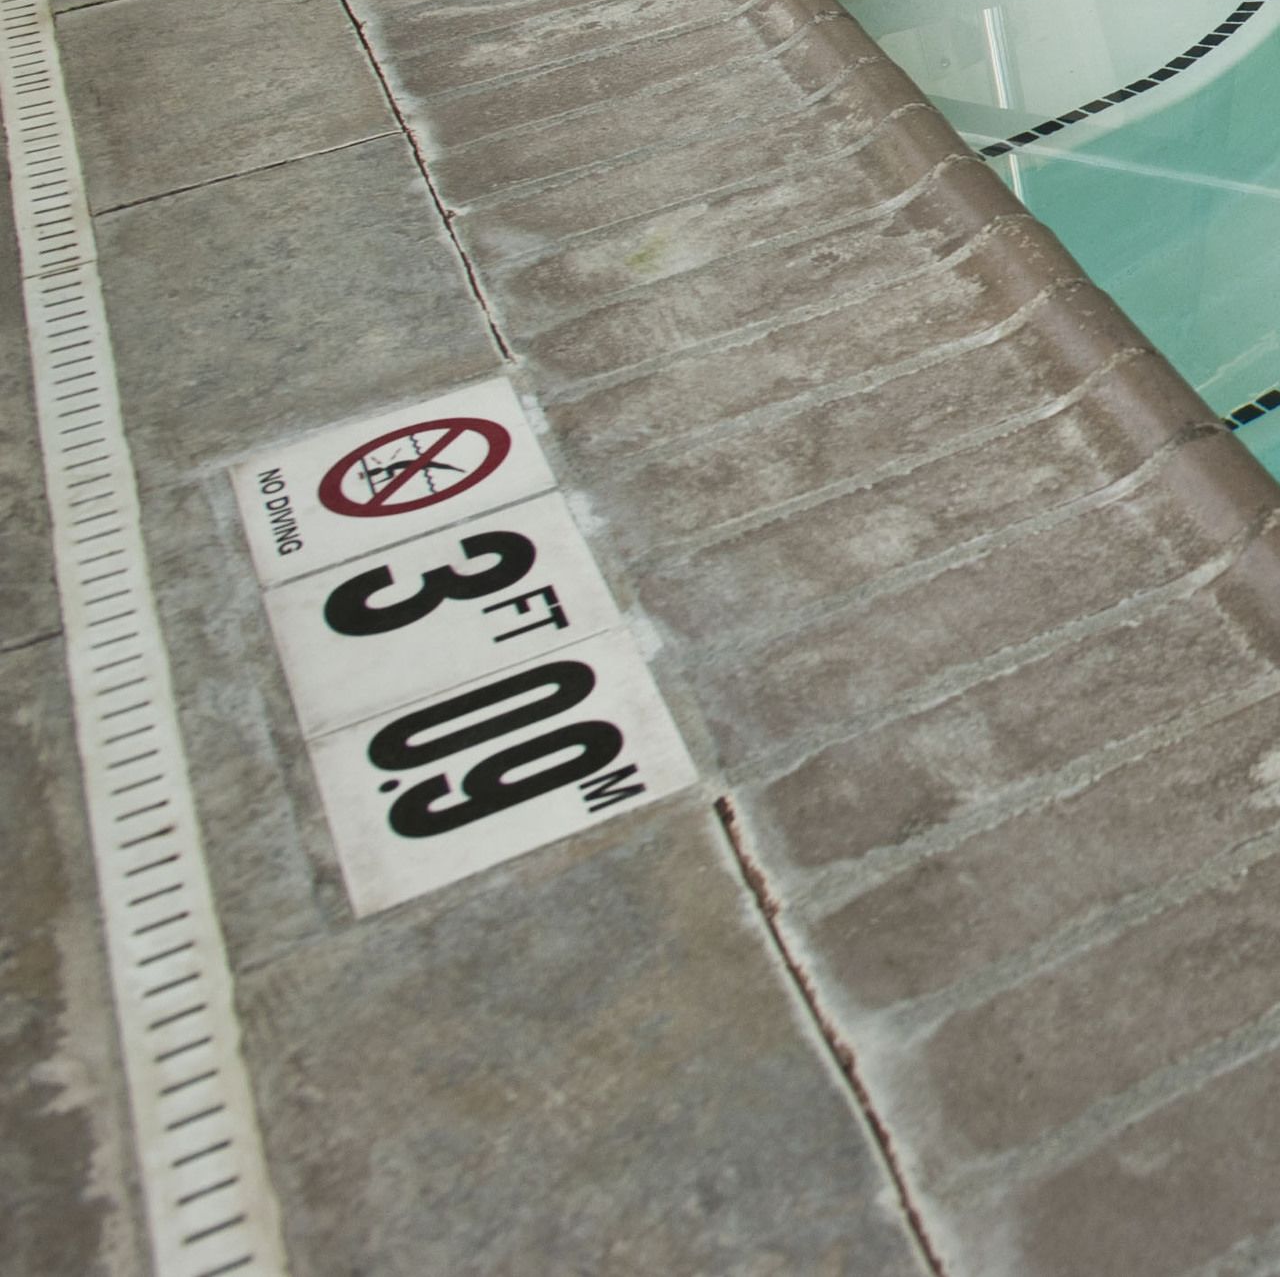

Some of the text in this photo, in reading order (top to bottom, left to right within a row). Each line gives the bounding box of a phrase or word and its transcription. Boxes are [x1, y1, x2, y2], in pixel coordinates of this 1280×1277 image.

[257, 468, 304, 556] NO DIVING
[324, 530, 647, 839] 3 FT 0.9 M
